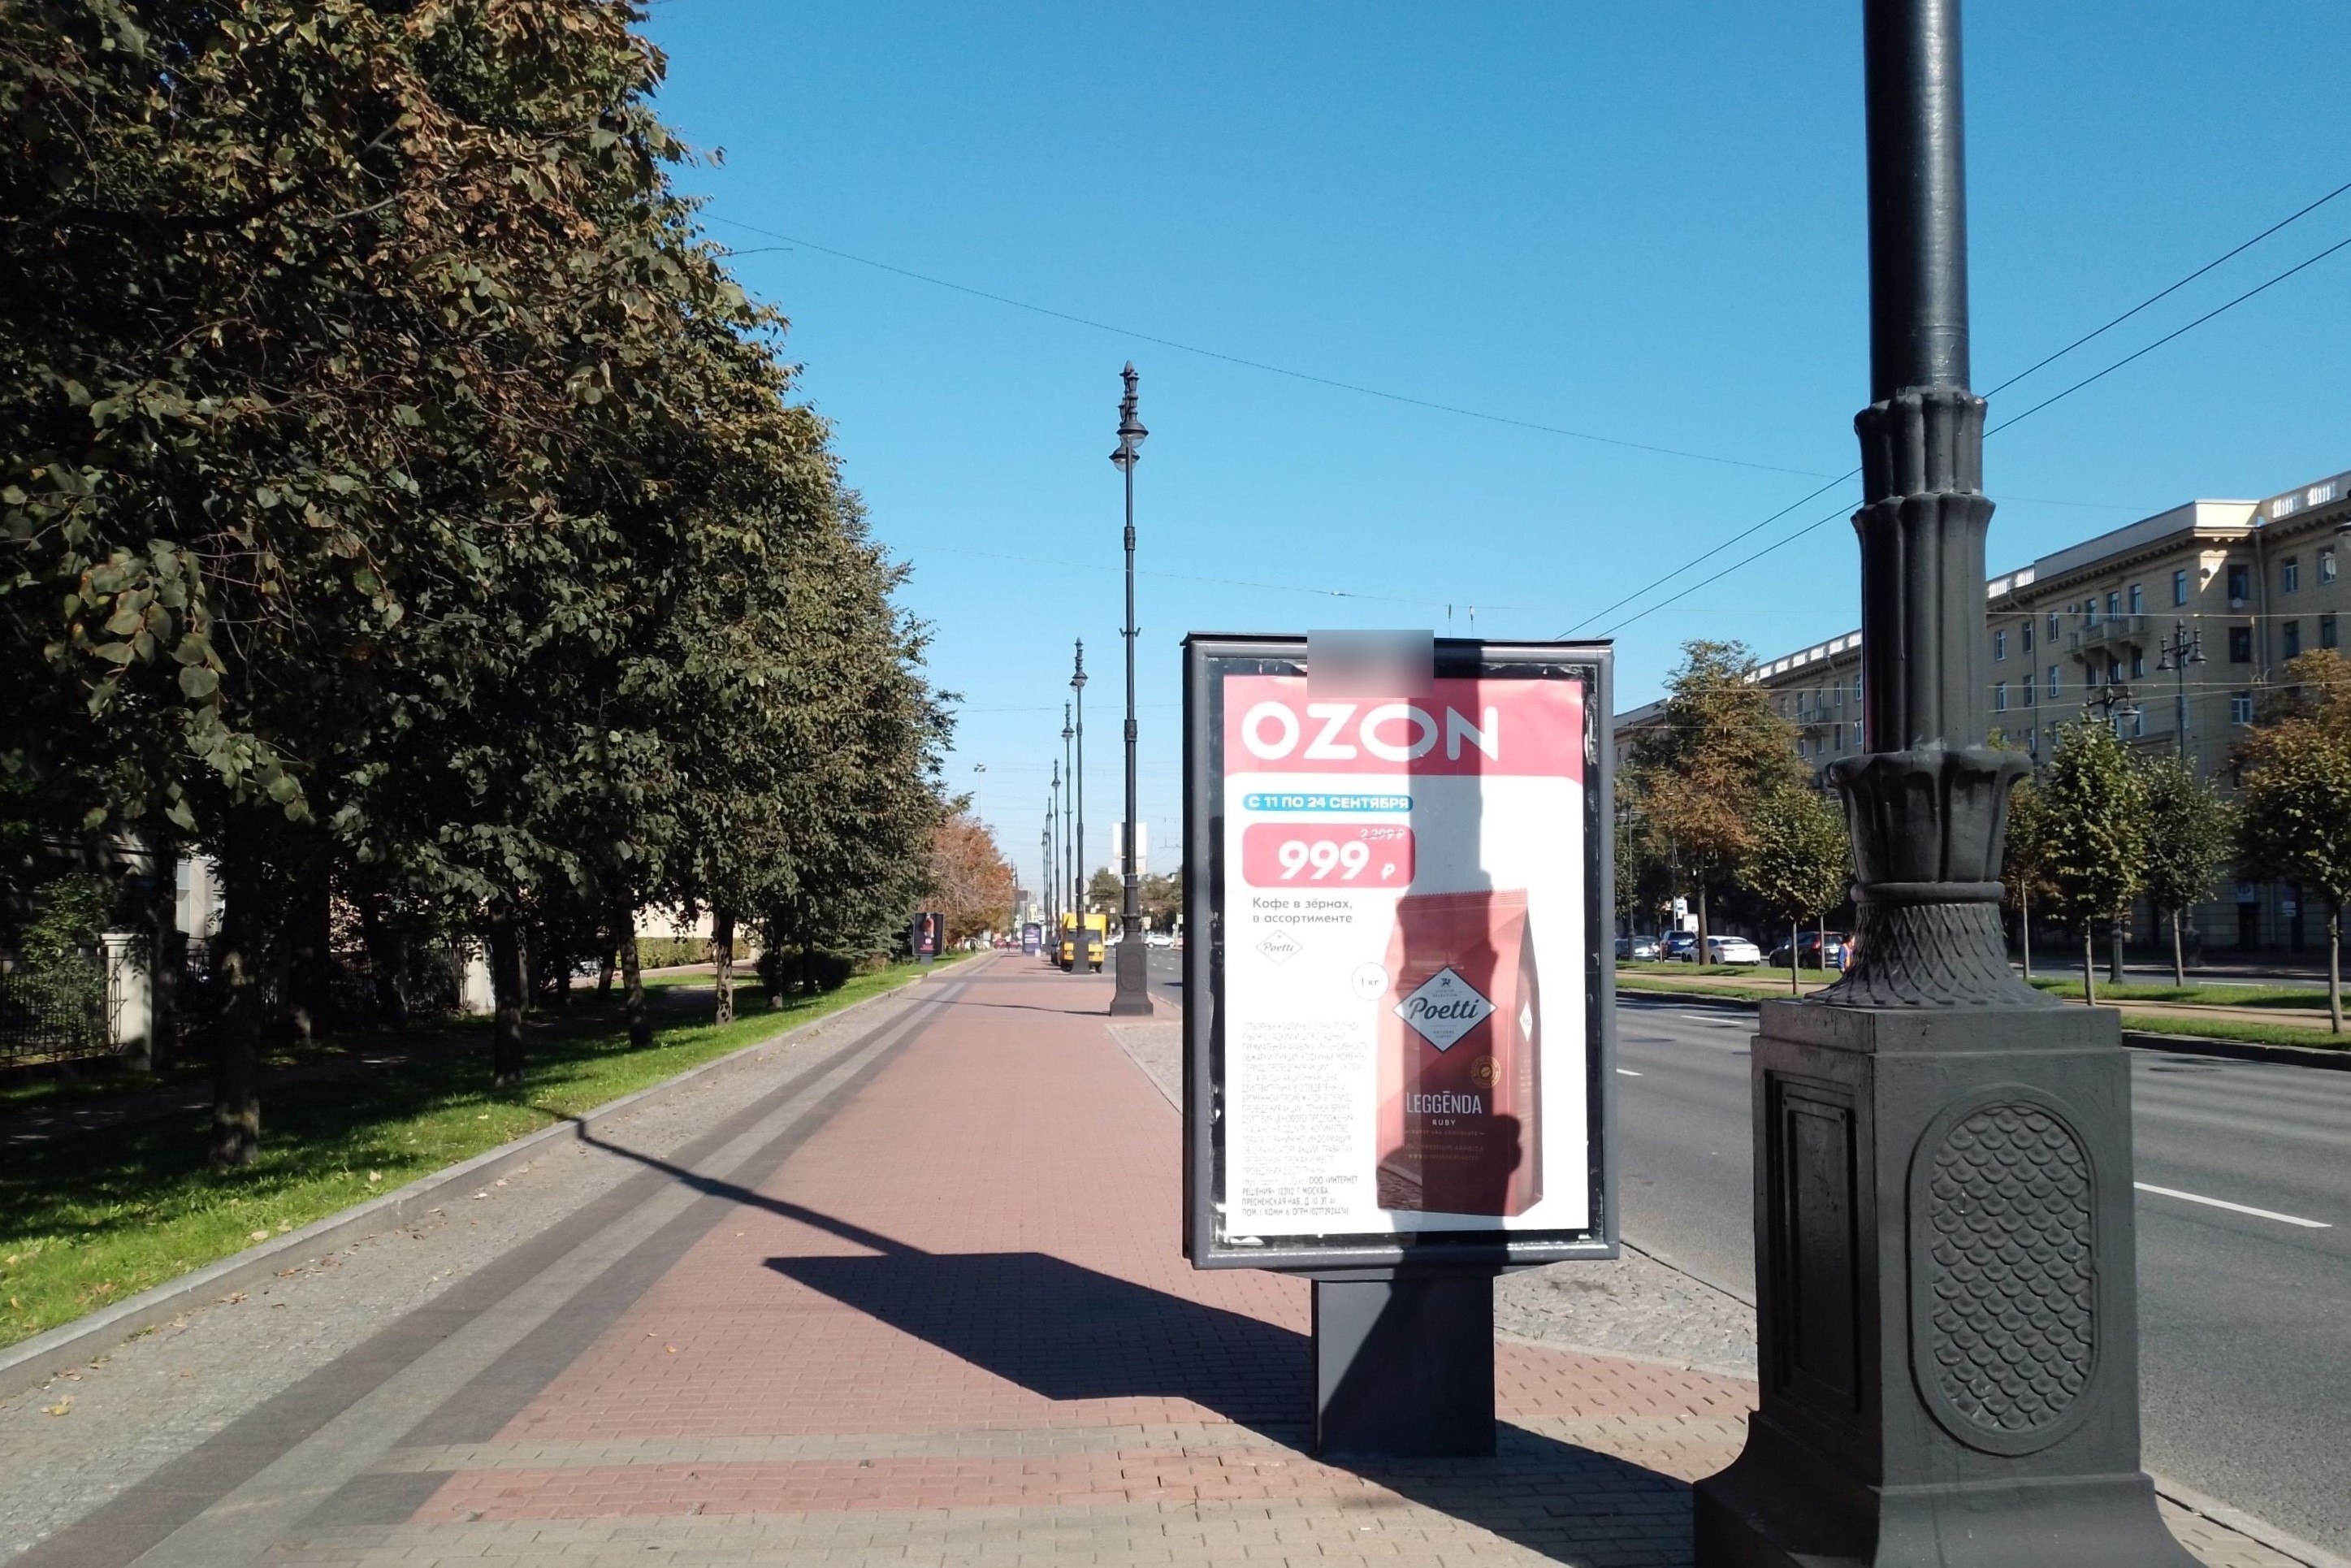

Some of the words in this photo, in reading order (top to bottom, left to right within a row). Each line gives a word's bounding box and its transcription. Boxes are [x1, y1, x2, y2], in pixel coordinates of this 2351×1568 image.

[1241, 700, 1499, 763] OZON
[1248, 797, 1261, 808] С
[1263, 797, 1279, 808] 11
[1281, 797, 1304, 808] ПО
[1306, 797, 1326, 808] 24
[1329, 797, 1409, 809] СЕНТЯБРЯ
[1278, 839, 1370, 880] 999
[1253, 897, 1289, 910] Кофе
[1305, 898, 1353, 910] зёрнах,
[1253, 915, 1259, 923] в
[1264, 915, 1353, 925] ассортименте
[1262, 942, 1295, 952] Poetti
[1409, 997, 1480, 1020] Poetti
